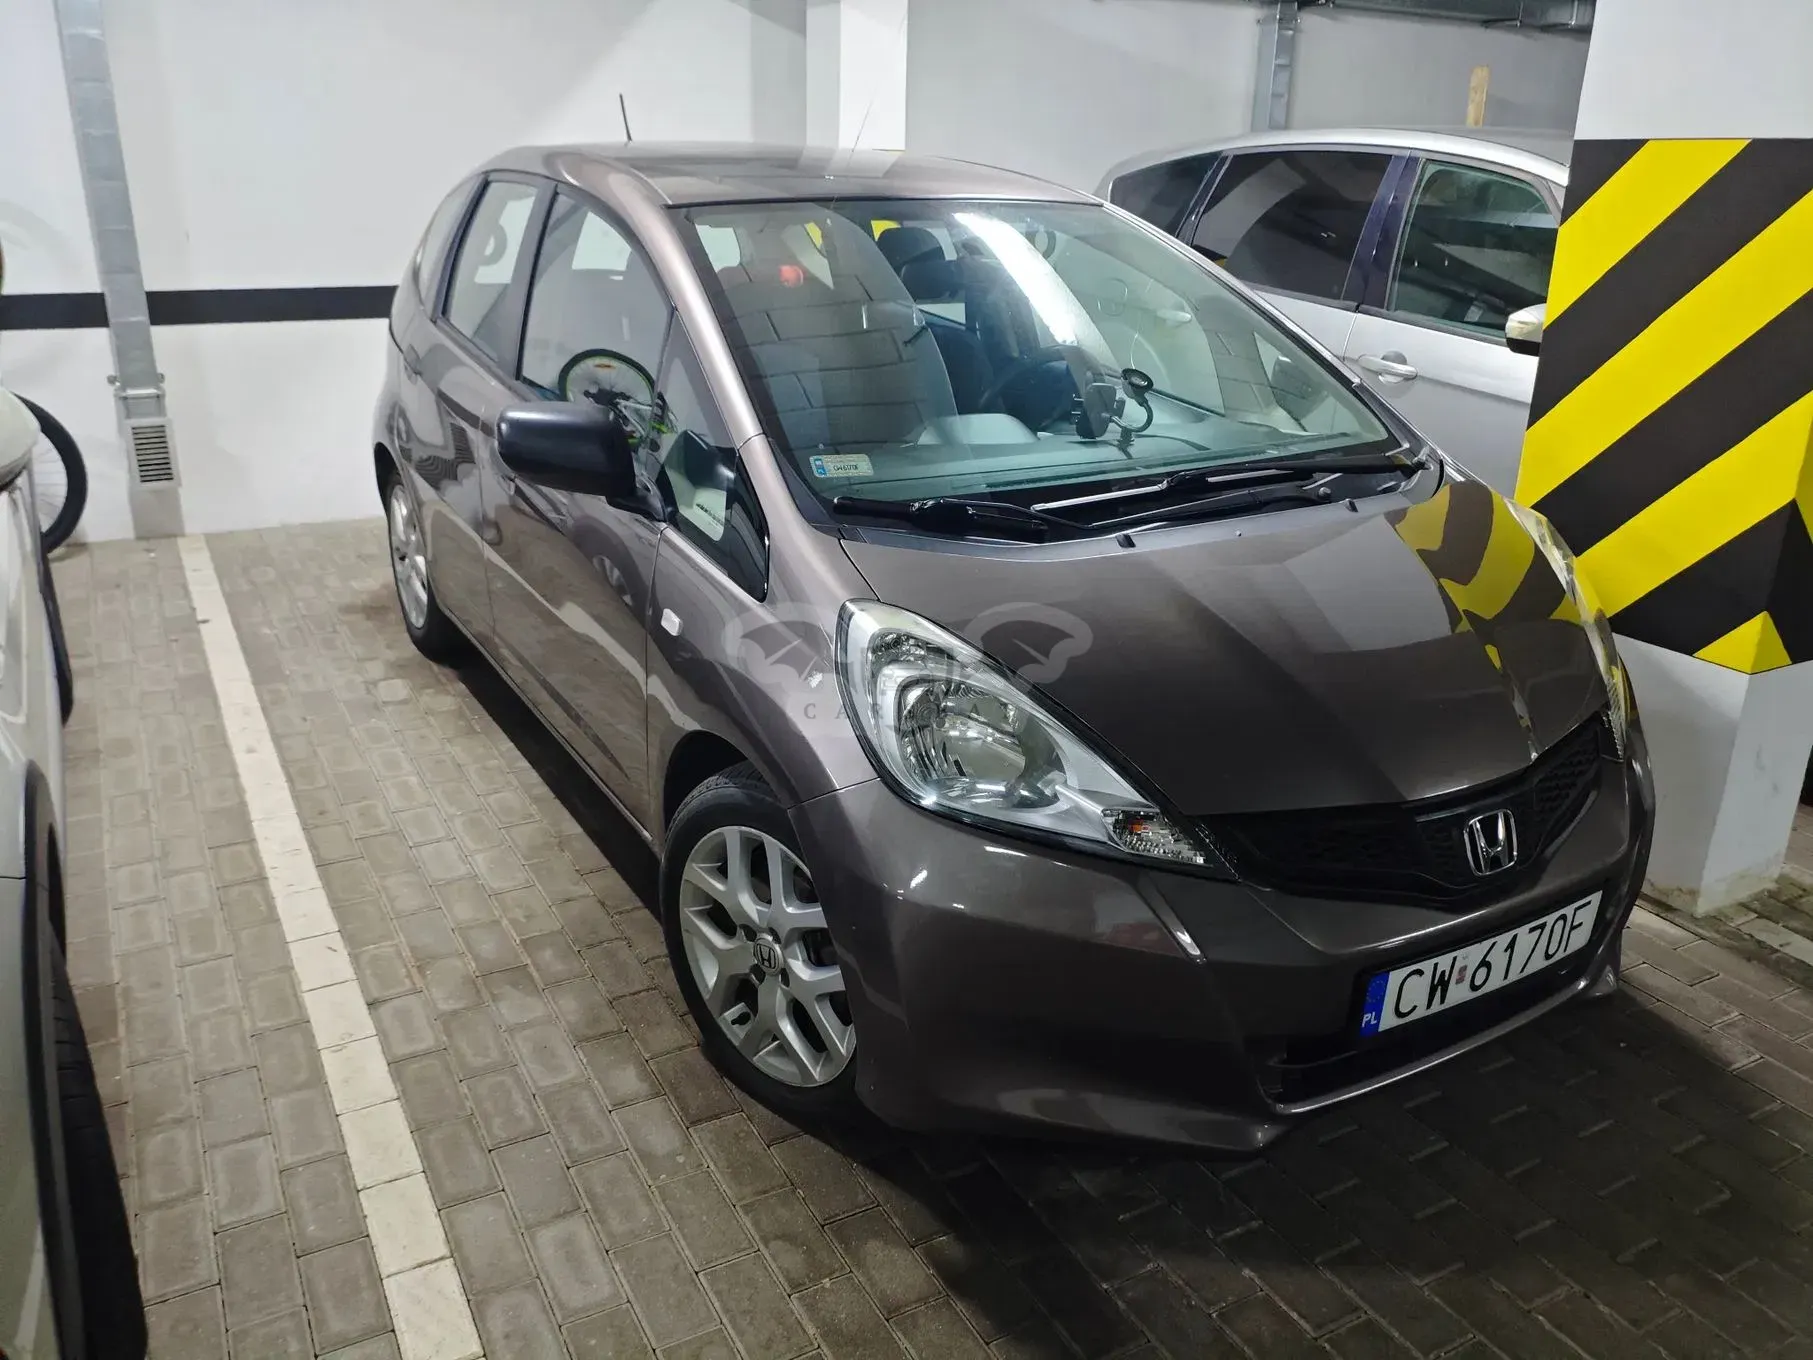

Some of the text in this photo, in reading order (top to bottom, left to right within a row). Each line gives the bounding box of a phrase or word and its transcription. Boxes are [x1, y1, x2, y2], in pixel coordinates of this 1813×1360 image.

[1394, 900, 1592, 1019] CW 6170F
[1361, 1011, 1378, 1028] PL
